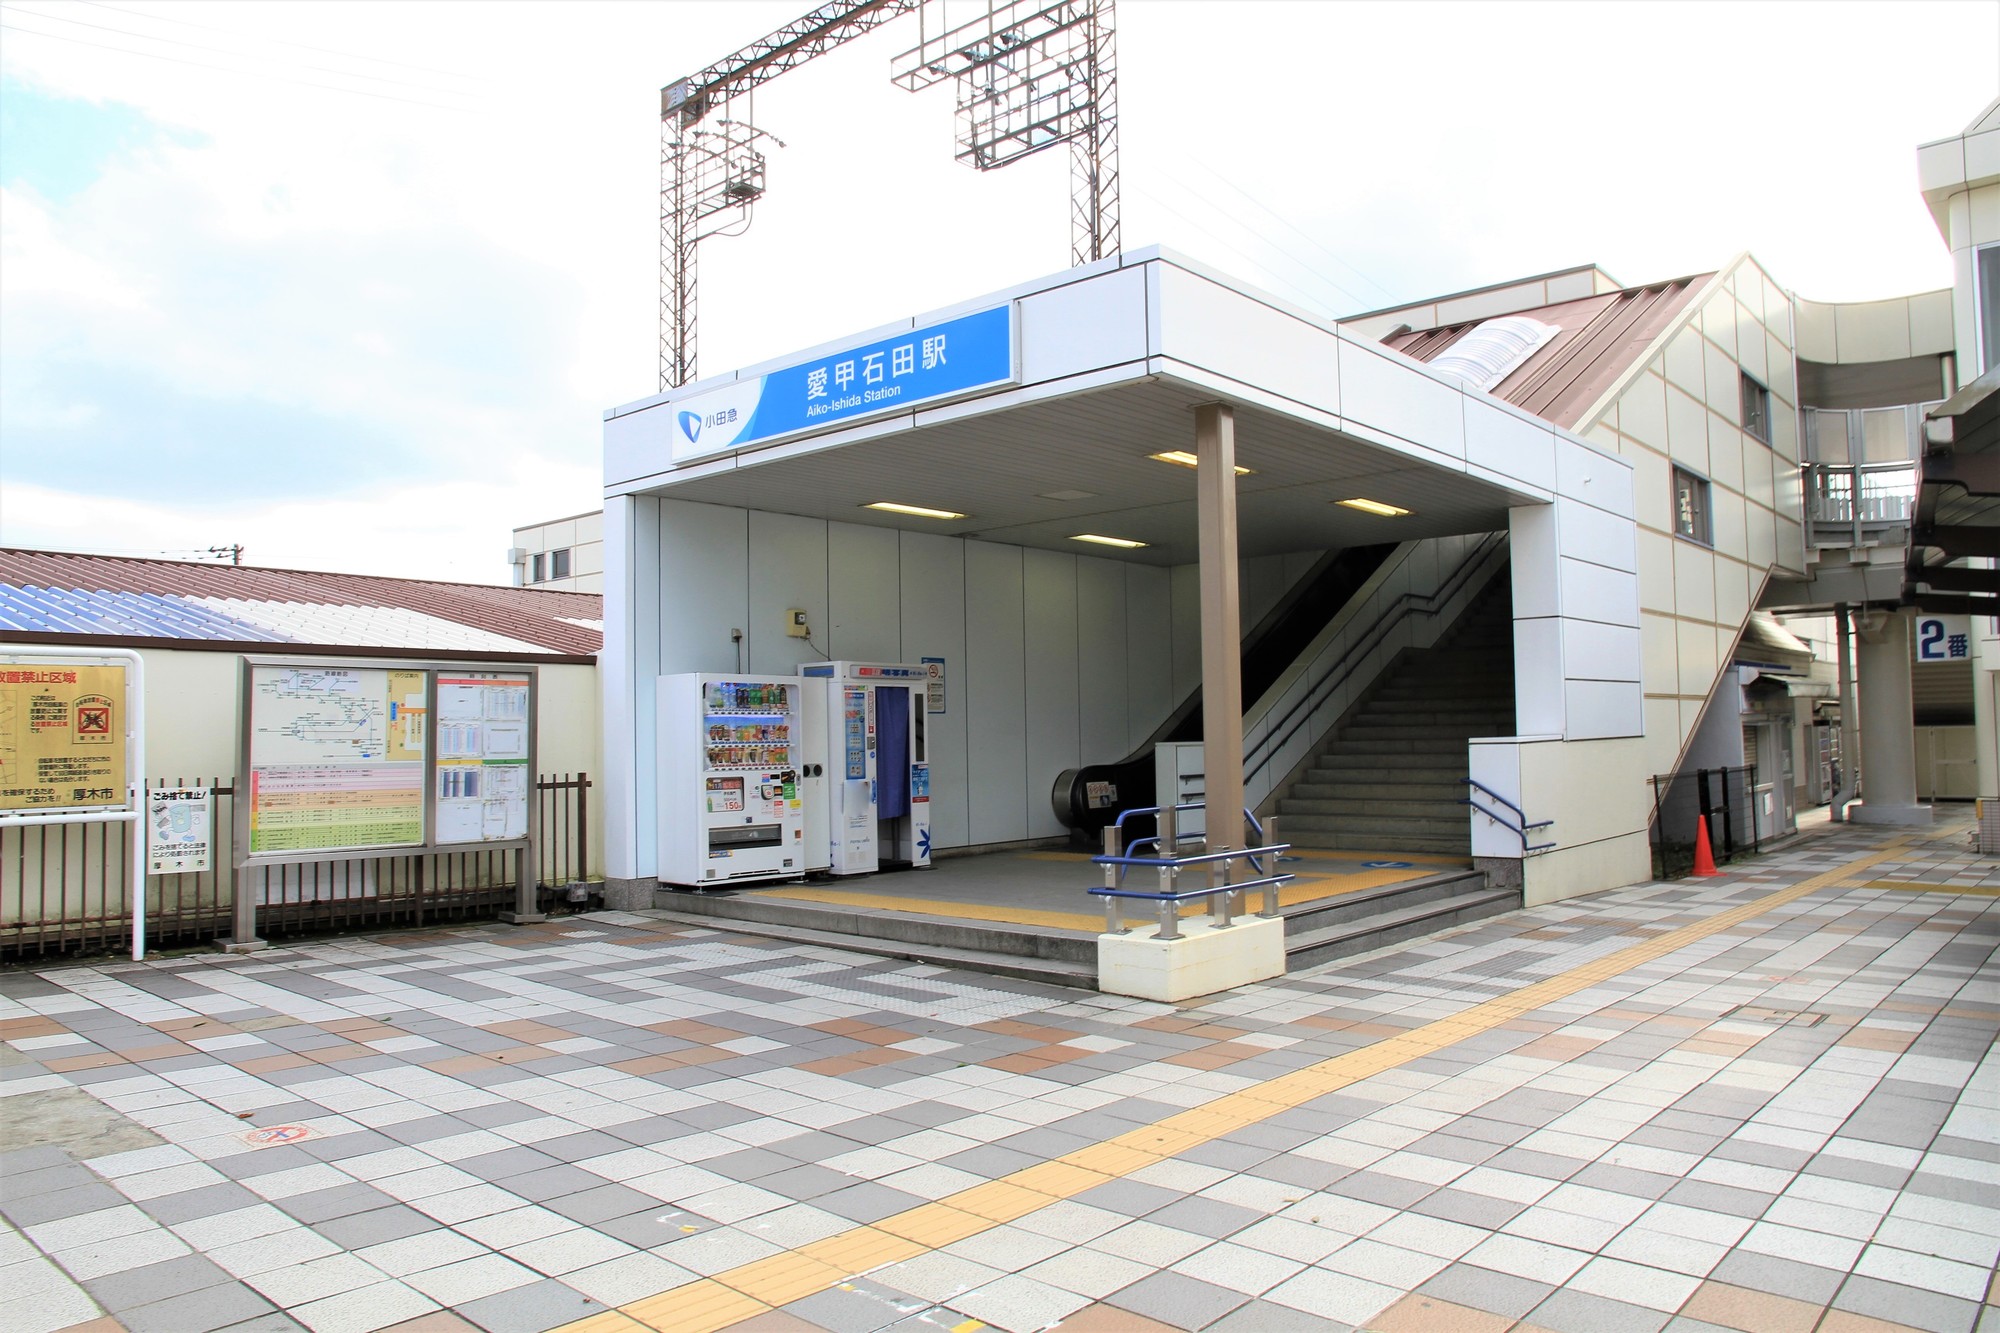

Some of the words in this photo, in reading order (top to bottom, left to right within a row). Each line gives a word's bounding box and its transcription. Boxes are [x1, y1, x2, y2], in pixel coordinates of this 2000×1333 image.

[807, 333, 947, 400] 愛甲石田駅
[806, 394, 861, 418] Aiko-Ishida
[864, 385, 901, 403] Station
[705, 408, 738, 429] 小田急
[1920, 619, 1968, 659] 2番
[73, 787, 114, 800] 厚木市
